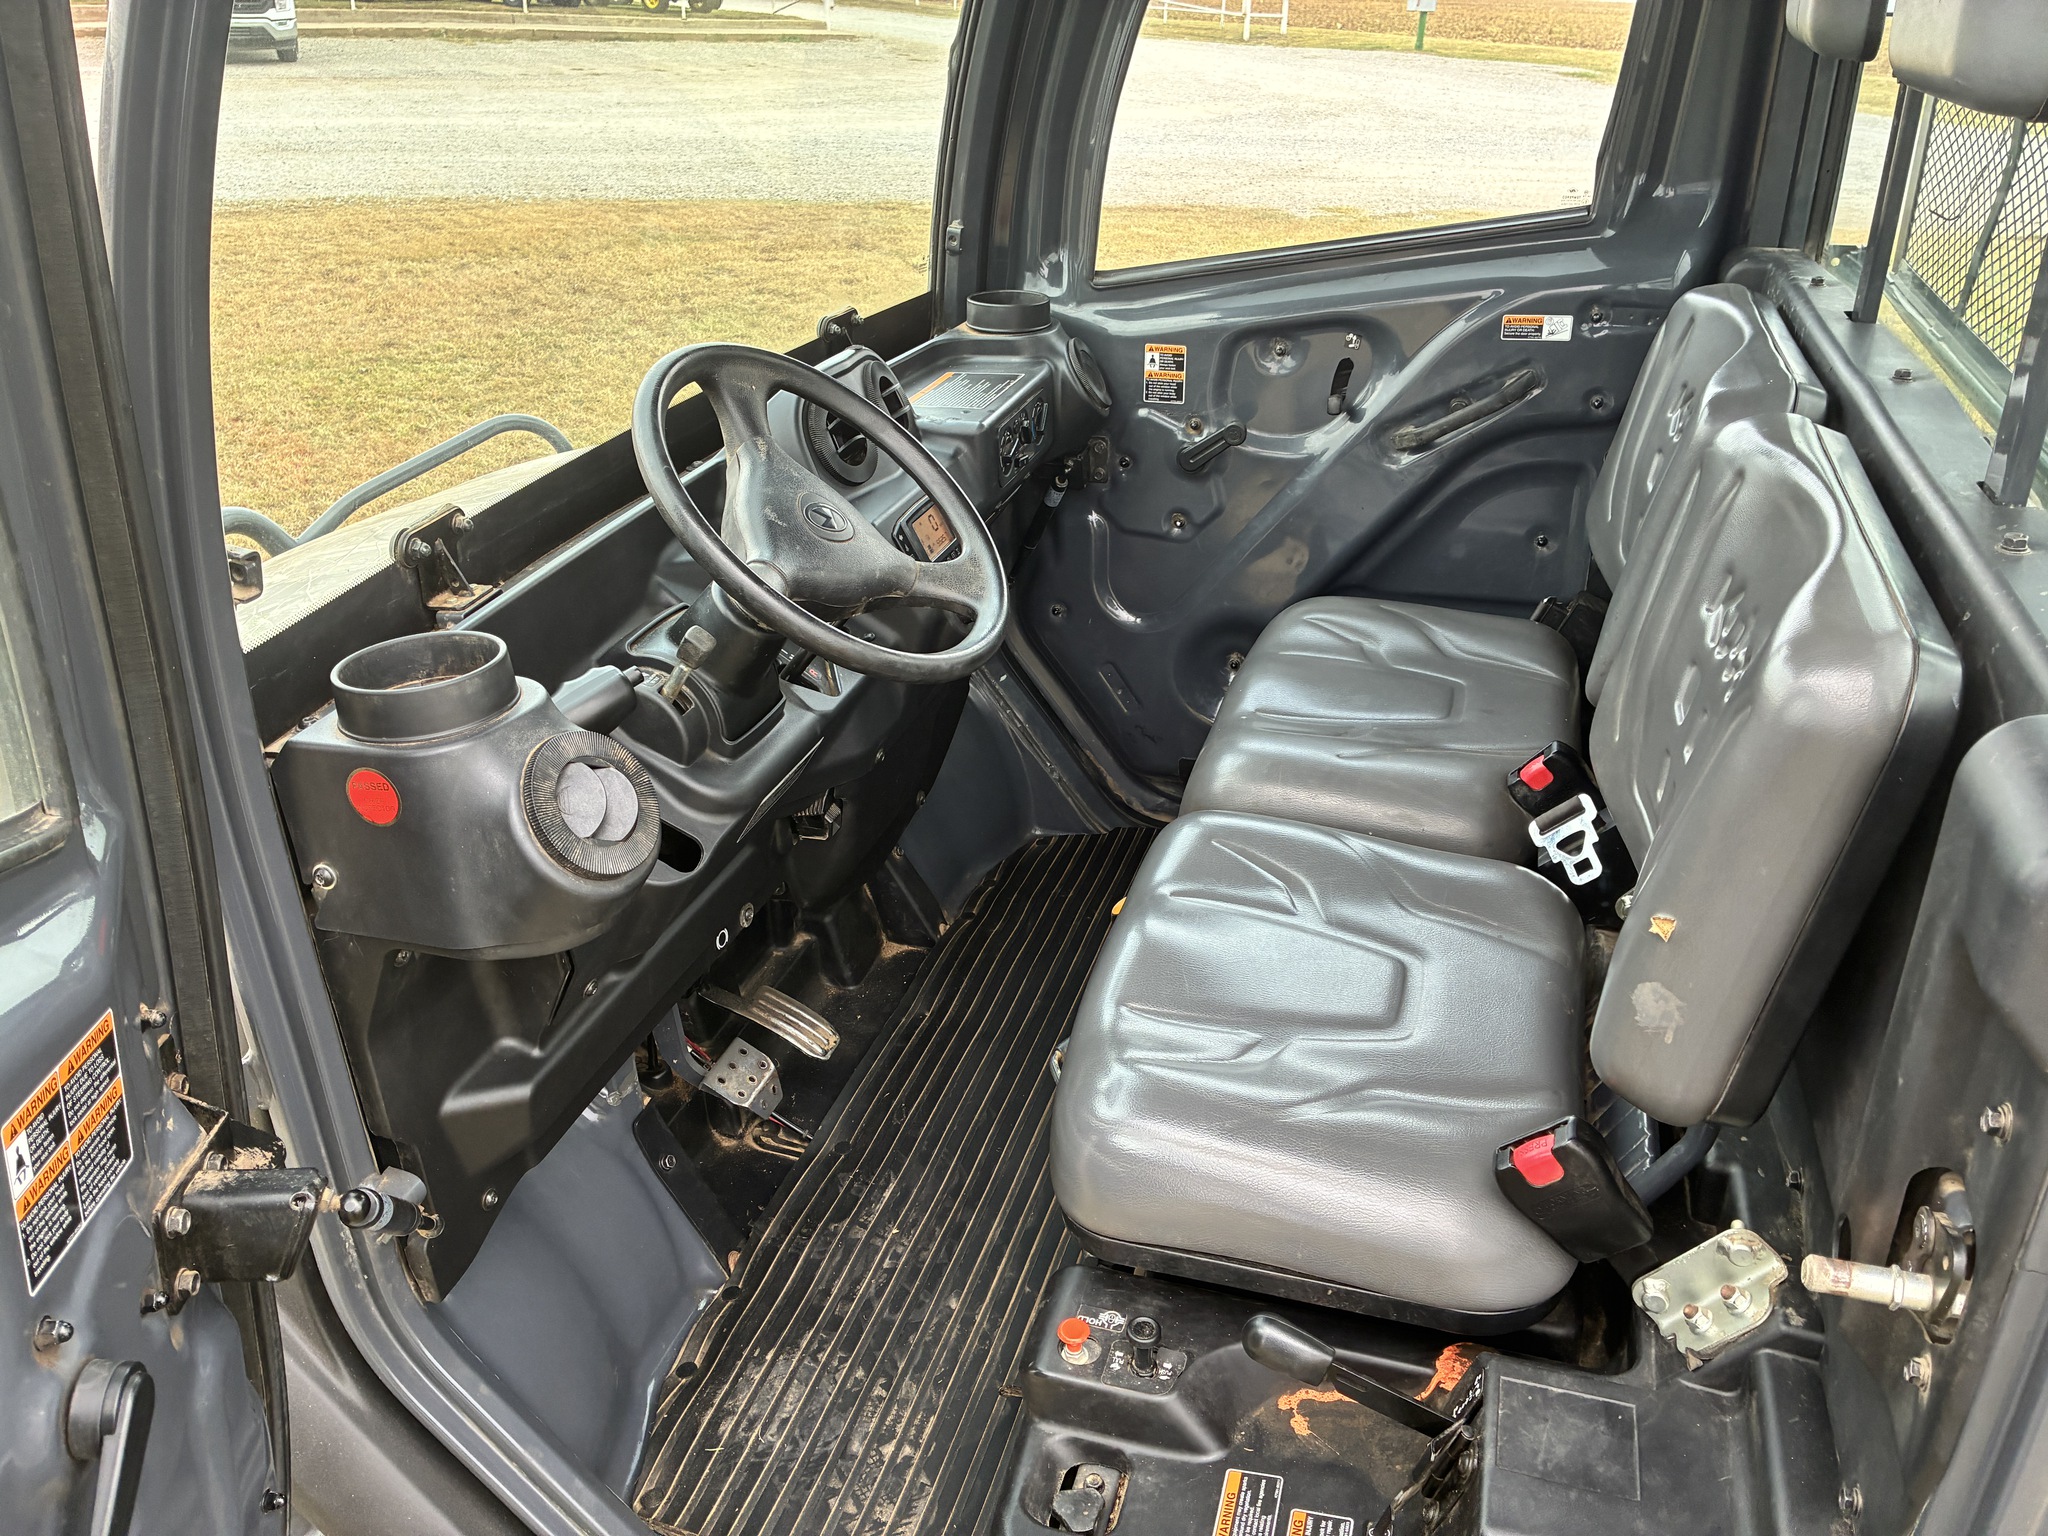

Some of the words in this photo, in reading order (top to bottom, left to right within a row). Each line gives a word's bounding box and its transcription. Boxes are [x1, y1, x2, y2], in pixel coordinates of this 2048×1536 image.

[352, 782, 390, 792] PASSED
[74, 1020, 109, 1064] WARNING
[17, 1078, 57, 1127] WARNING
[84, 1087, 117, 1133] WARNING
[30, 1147, 68, 1199] WARNING
[1112, 1357, 1125, 1365] PULL
